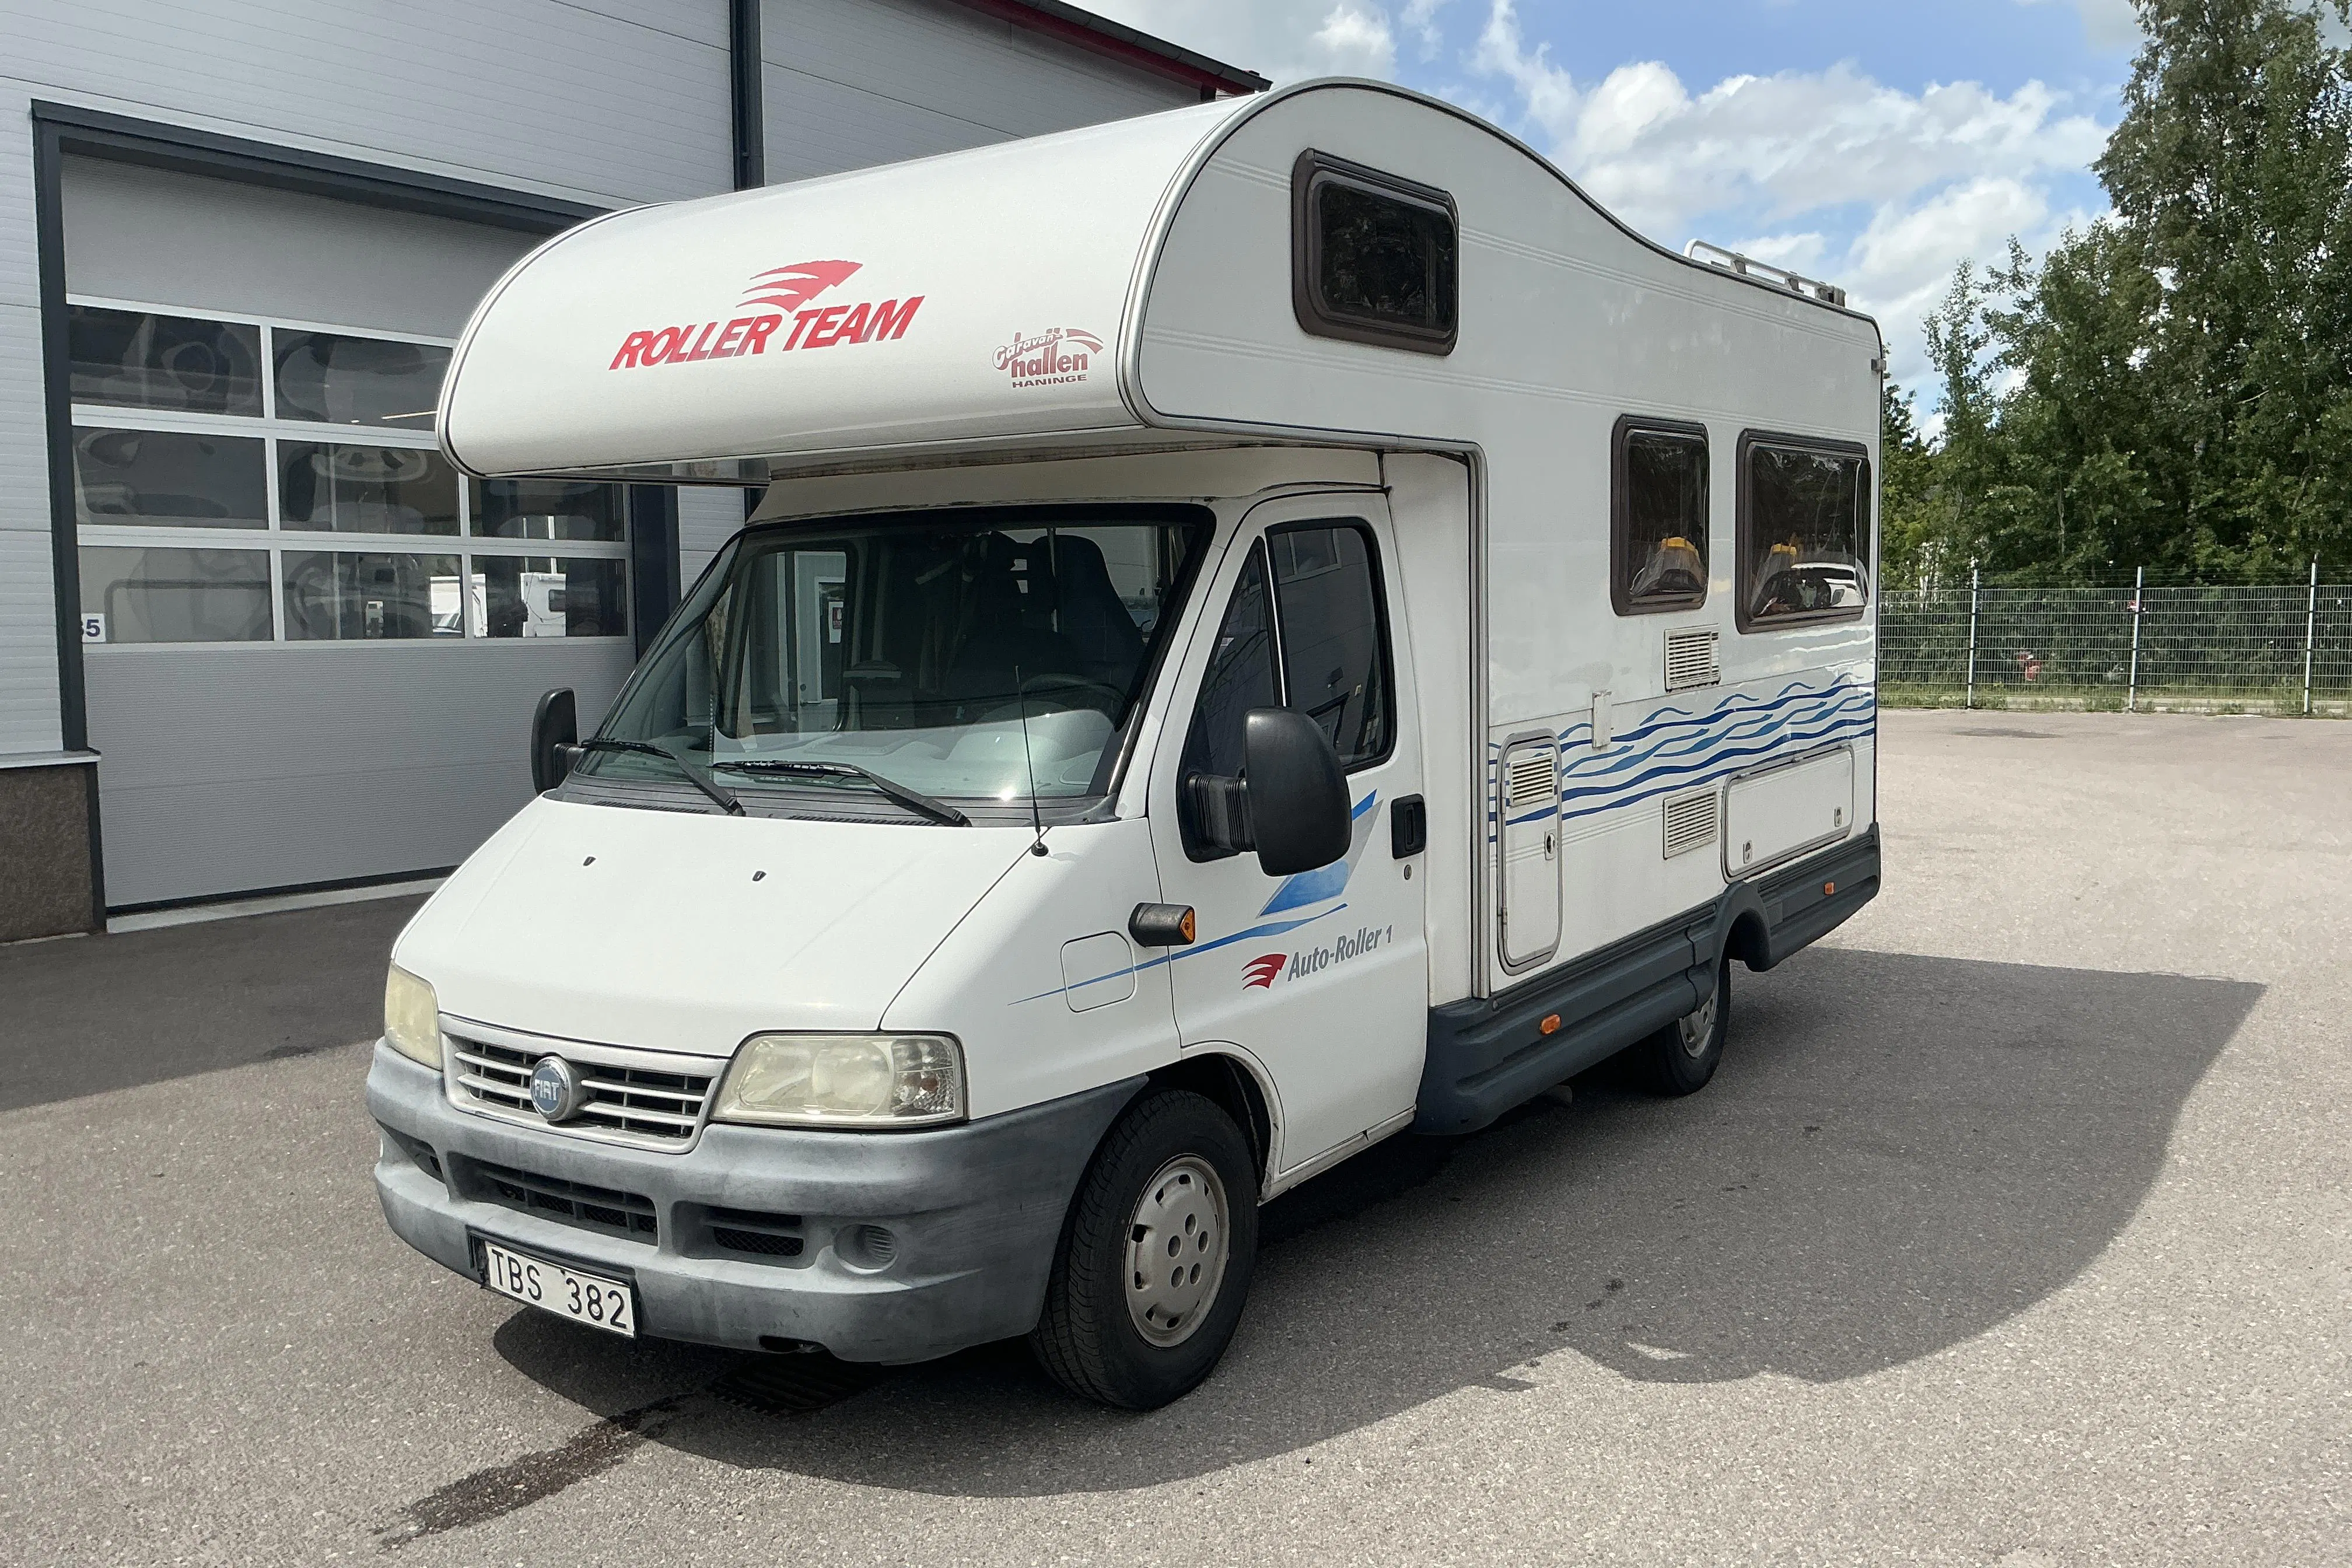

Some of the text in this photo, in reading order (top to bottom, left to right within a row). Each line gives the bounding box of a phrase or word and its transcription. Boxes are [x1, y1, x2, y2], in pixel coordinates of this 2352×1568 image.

[608, 295, 925, 370] ROLLER TEAM
[1011, 327, 1088, 379] hallen
[1012, 374, 1087, 388] HANINGE
[81, 618, 101, 638] 5
[1287, 924, 1392, 982] Auto-Roller 1
[534, 1078, 559, 1101] FIAT
[491, 1248, 627, 1329] TBS 382
